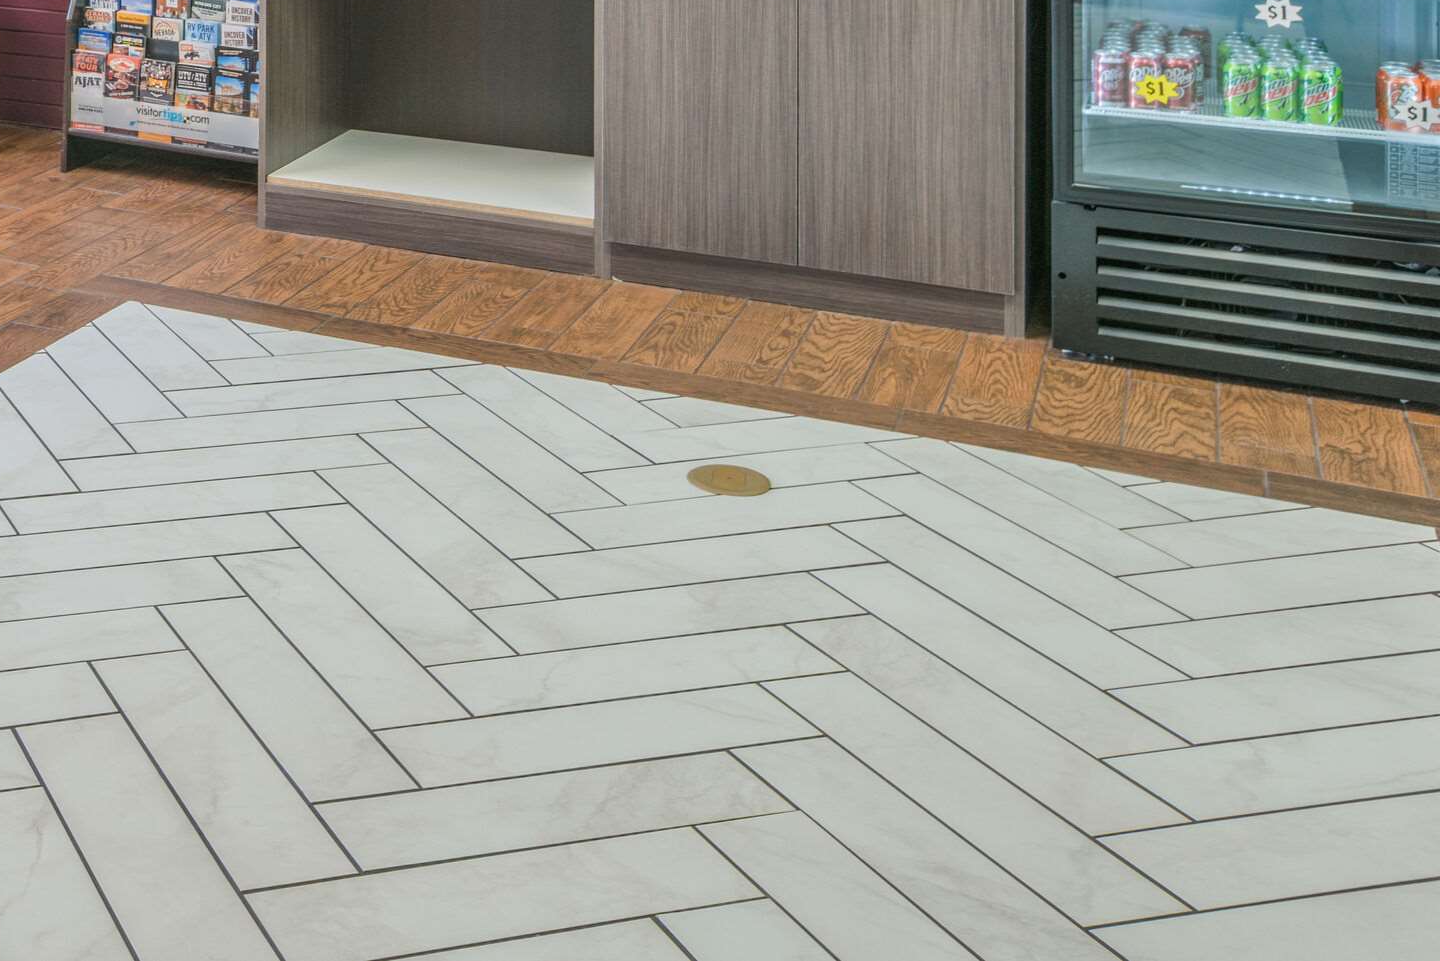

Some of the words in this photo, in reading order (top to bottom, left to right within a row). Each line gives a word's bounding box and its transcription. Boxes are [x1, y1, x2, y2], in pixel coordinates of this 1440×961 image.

[1268, 5, 1288, 20] $1
[187, 23, 195, 31] RV
[197, 24, 216, 33] PARK
[199, 33, 211, 41] ATV
[1146, 81, 1165, 97] $1
[1407, 106, 1429, 122] $1
